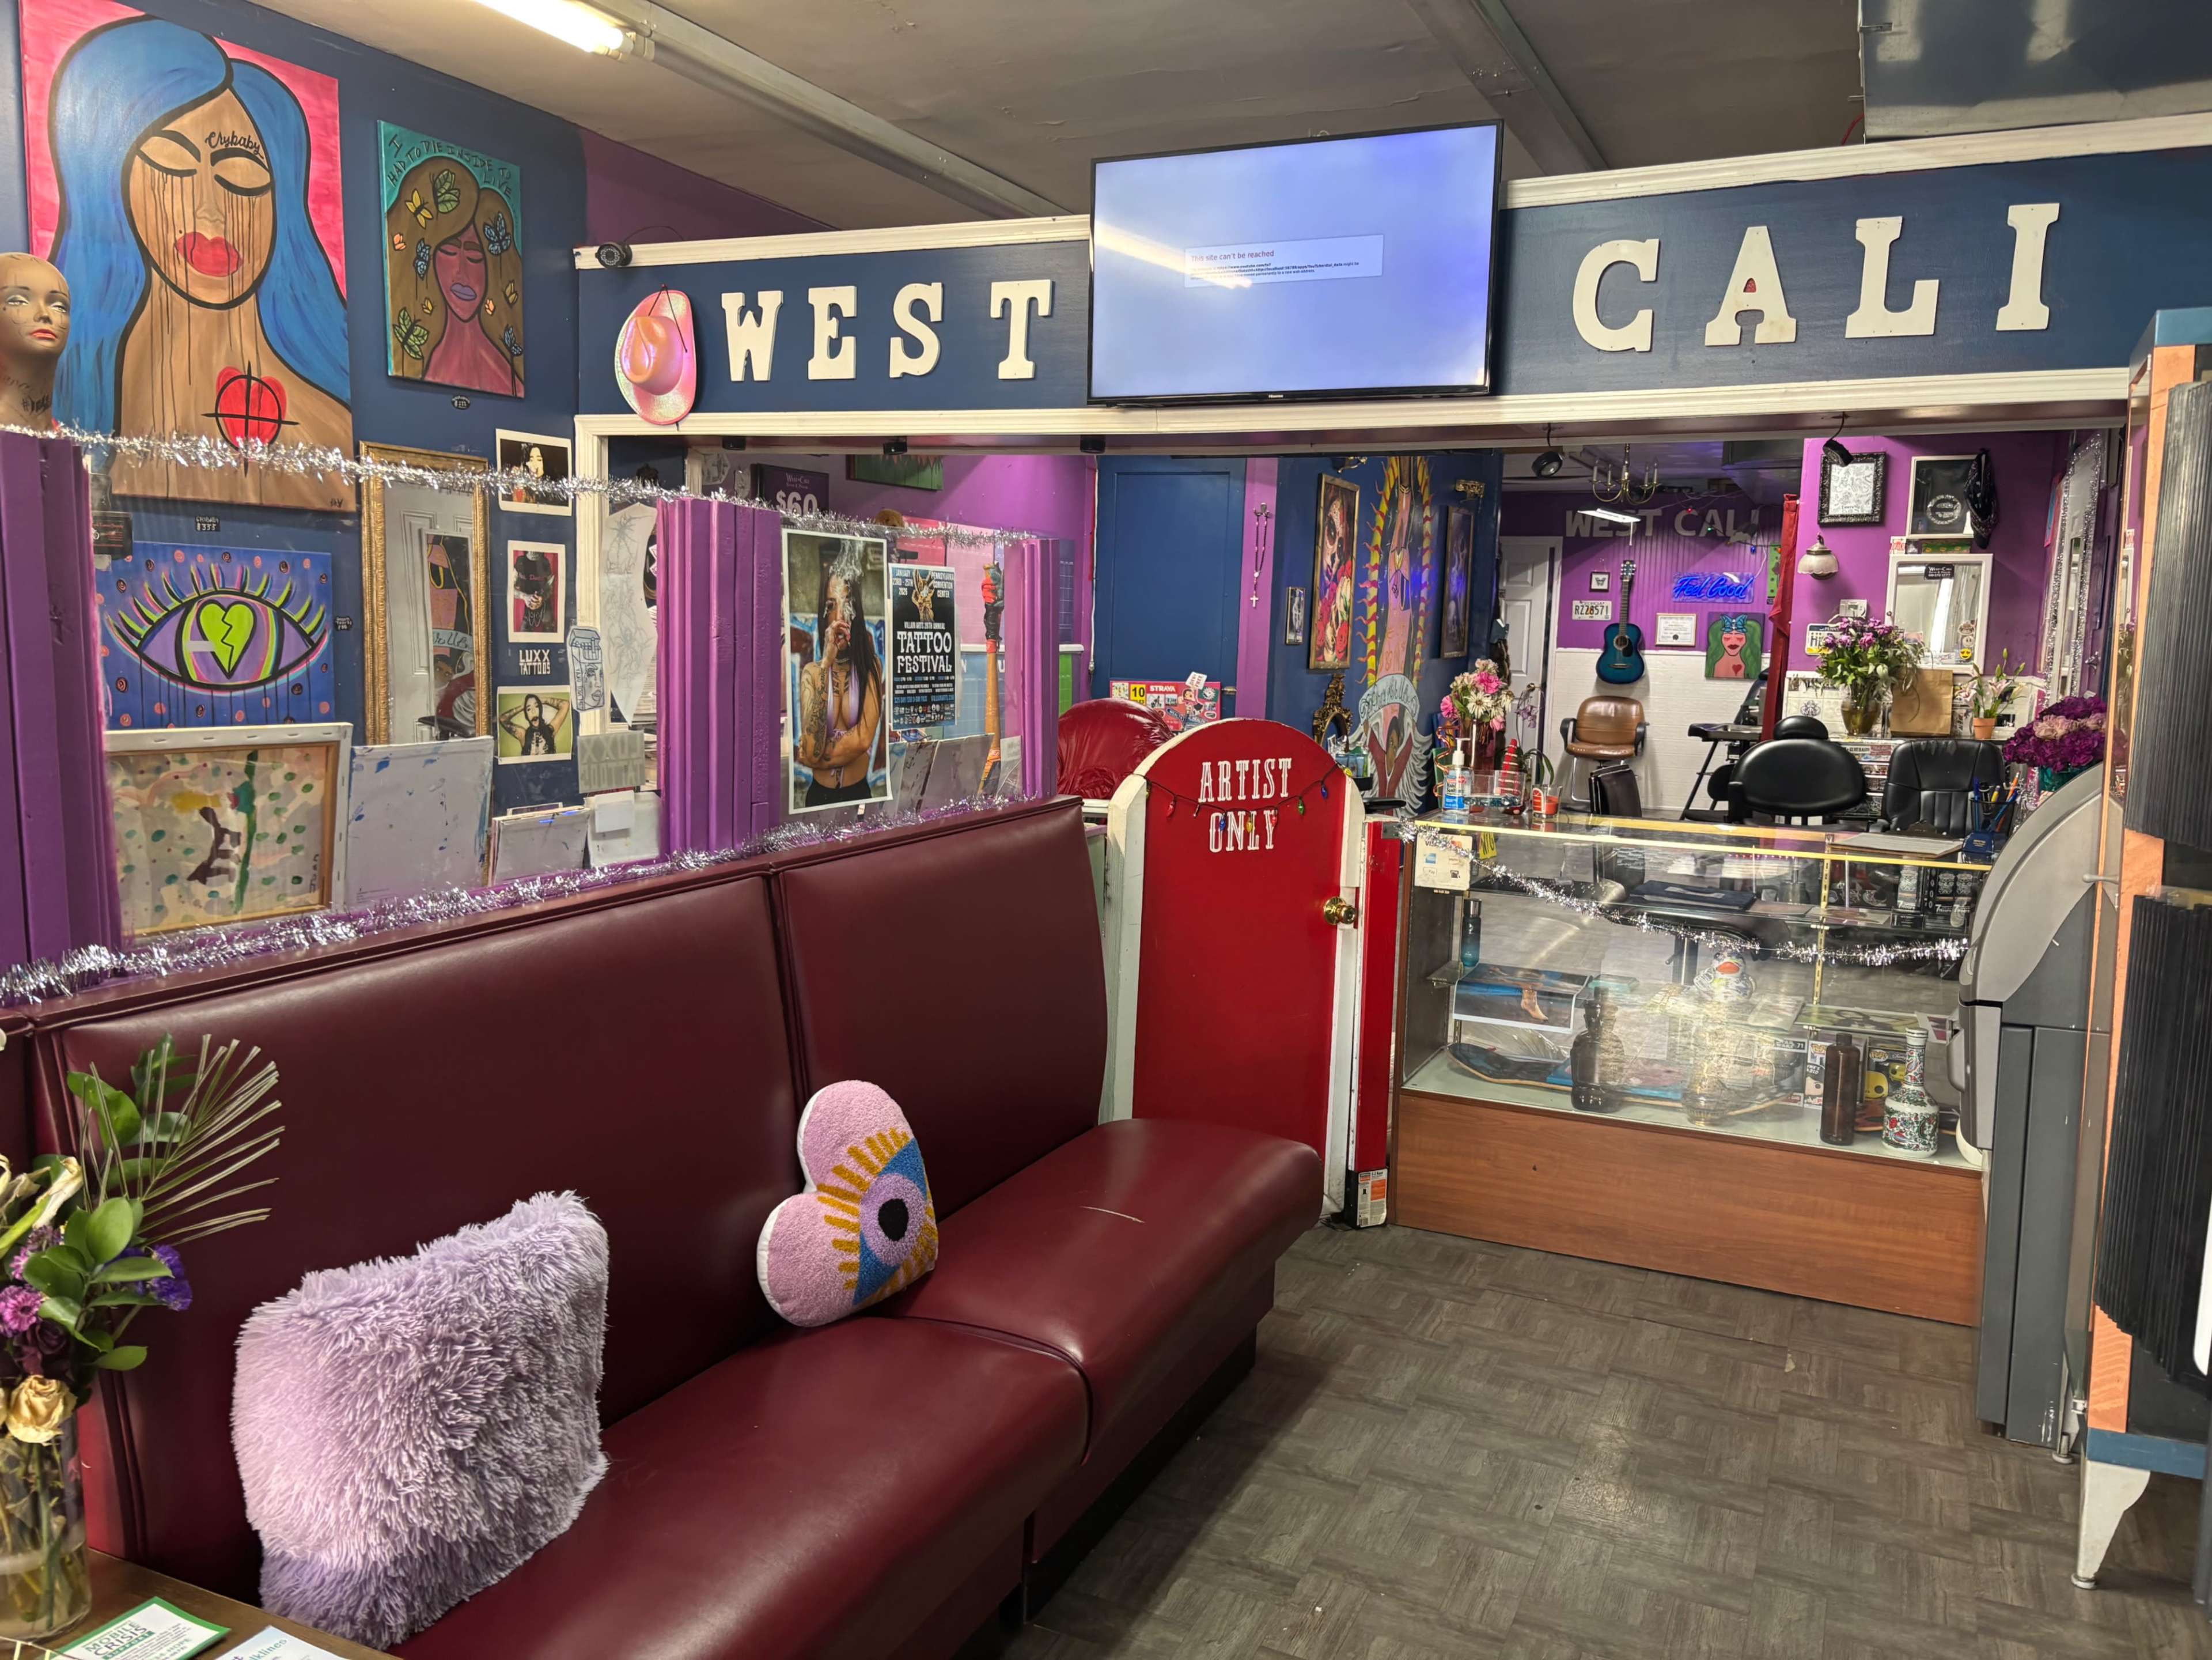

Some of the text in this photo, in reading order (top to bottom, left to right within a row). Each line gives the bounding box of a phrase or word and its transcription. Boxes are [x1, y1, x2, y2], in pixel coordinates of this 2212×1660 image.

[387, 140, 512, 188] HAD TO DIE INSIDE TO
[483, 173, 512, 199] LIVE
[1247, 250, 1275, 258] reached
[1572, 202, 2061, 353] CALI
[721, 279, 1053, 381] WEST
[1673, 576, 1753, 599] Feel Good
[896, 631, 952, 653] TATTOO
[519, 649, 550, 662] LUXX
[519, 662, 551, 675] TATTOOS
[896, 655, 952, 674] FESTIVAL
[1132, 686, 1145, 698] 10
[1198, 757, 1293, 803] ARTIST
[1209, 810, 1278, 853] ONLY
[85, 1621, 141, 1652] MOBILE
[94, 1627, 147, 1656] CRISIS
